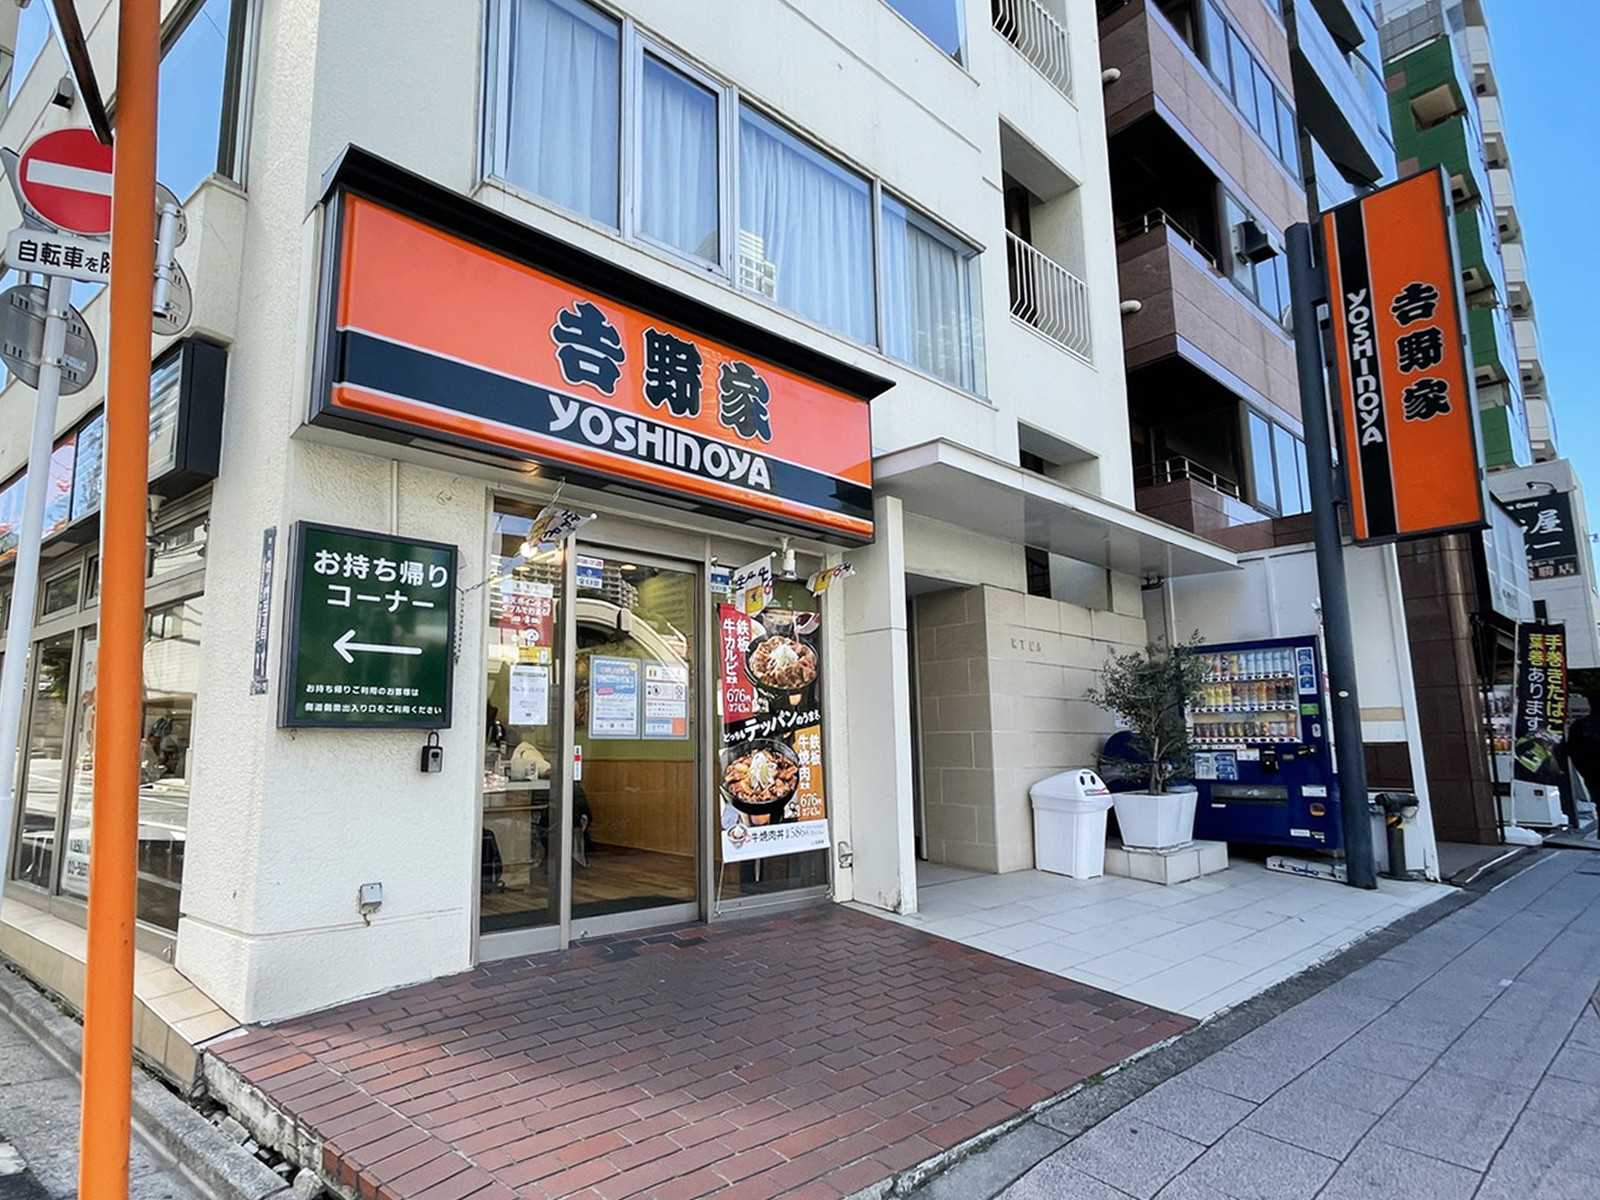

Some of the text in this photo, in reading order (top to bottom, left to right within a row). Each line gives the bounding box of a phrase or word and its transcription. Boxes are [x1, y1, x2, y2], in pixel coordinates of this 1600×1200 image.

[550, 300, 772, 443] 吉野家
[1346, 287, 1384, 446] YOSHINOYA
[1390, 282, 1451, 422] 吉野家
[548, 394, 772, 491] YOSHINOYA
[1515, 501, 1539, 510] Curry
[313, 549, 448, 588] お持ち帰り
[327, 584, 435, 613] コーナー
[736, 618, 751, 652] 鉄板
[305, 684, 420, 697] お持ち帰りご利用のお客様は
[1524, 633, 1545, 732] 葉巻あります
[1545, 633, 1564, 735] 手巻きたばこ
[809, 733, 821, 765] 鉄板
